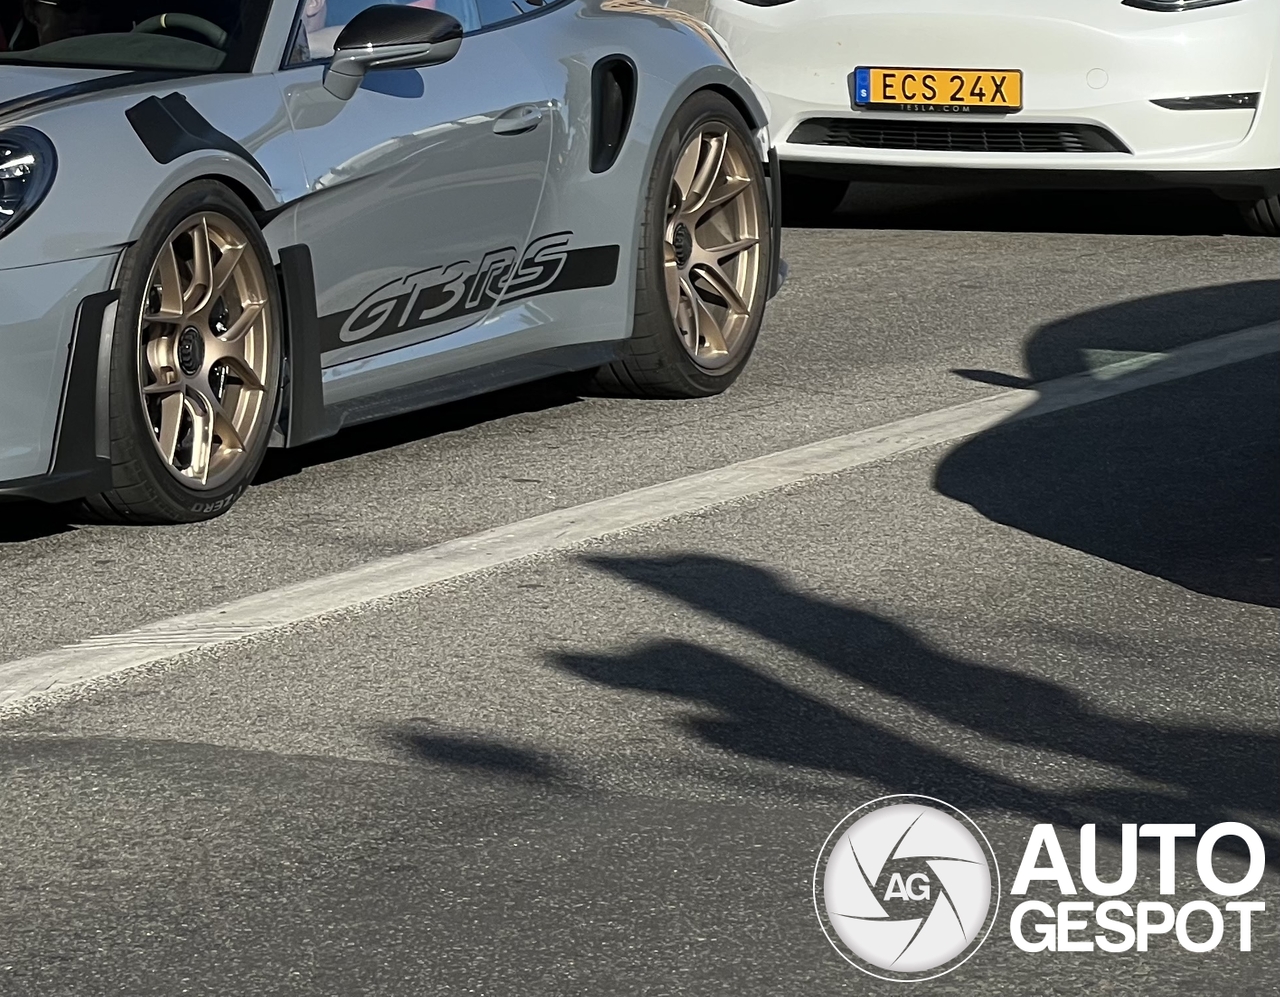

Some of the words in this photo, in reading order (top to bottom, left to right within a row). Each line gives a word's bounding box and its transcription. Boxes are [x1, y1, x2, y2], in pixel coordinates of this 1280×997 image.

[883, 73, 937, 101] ECS
[949, 75, 1007, 103] 24X
[900, 104, 970, 112] TESLA.COM
